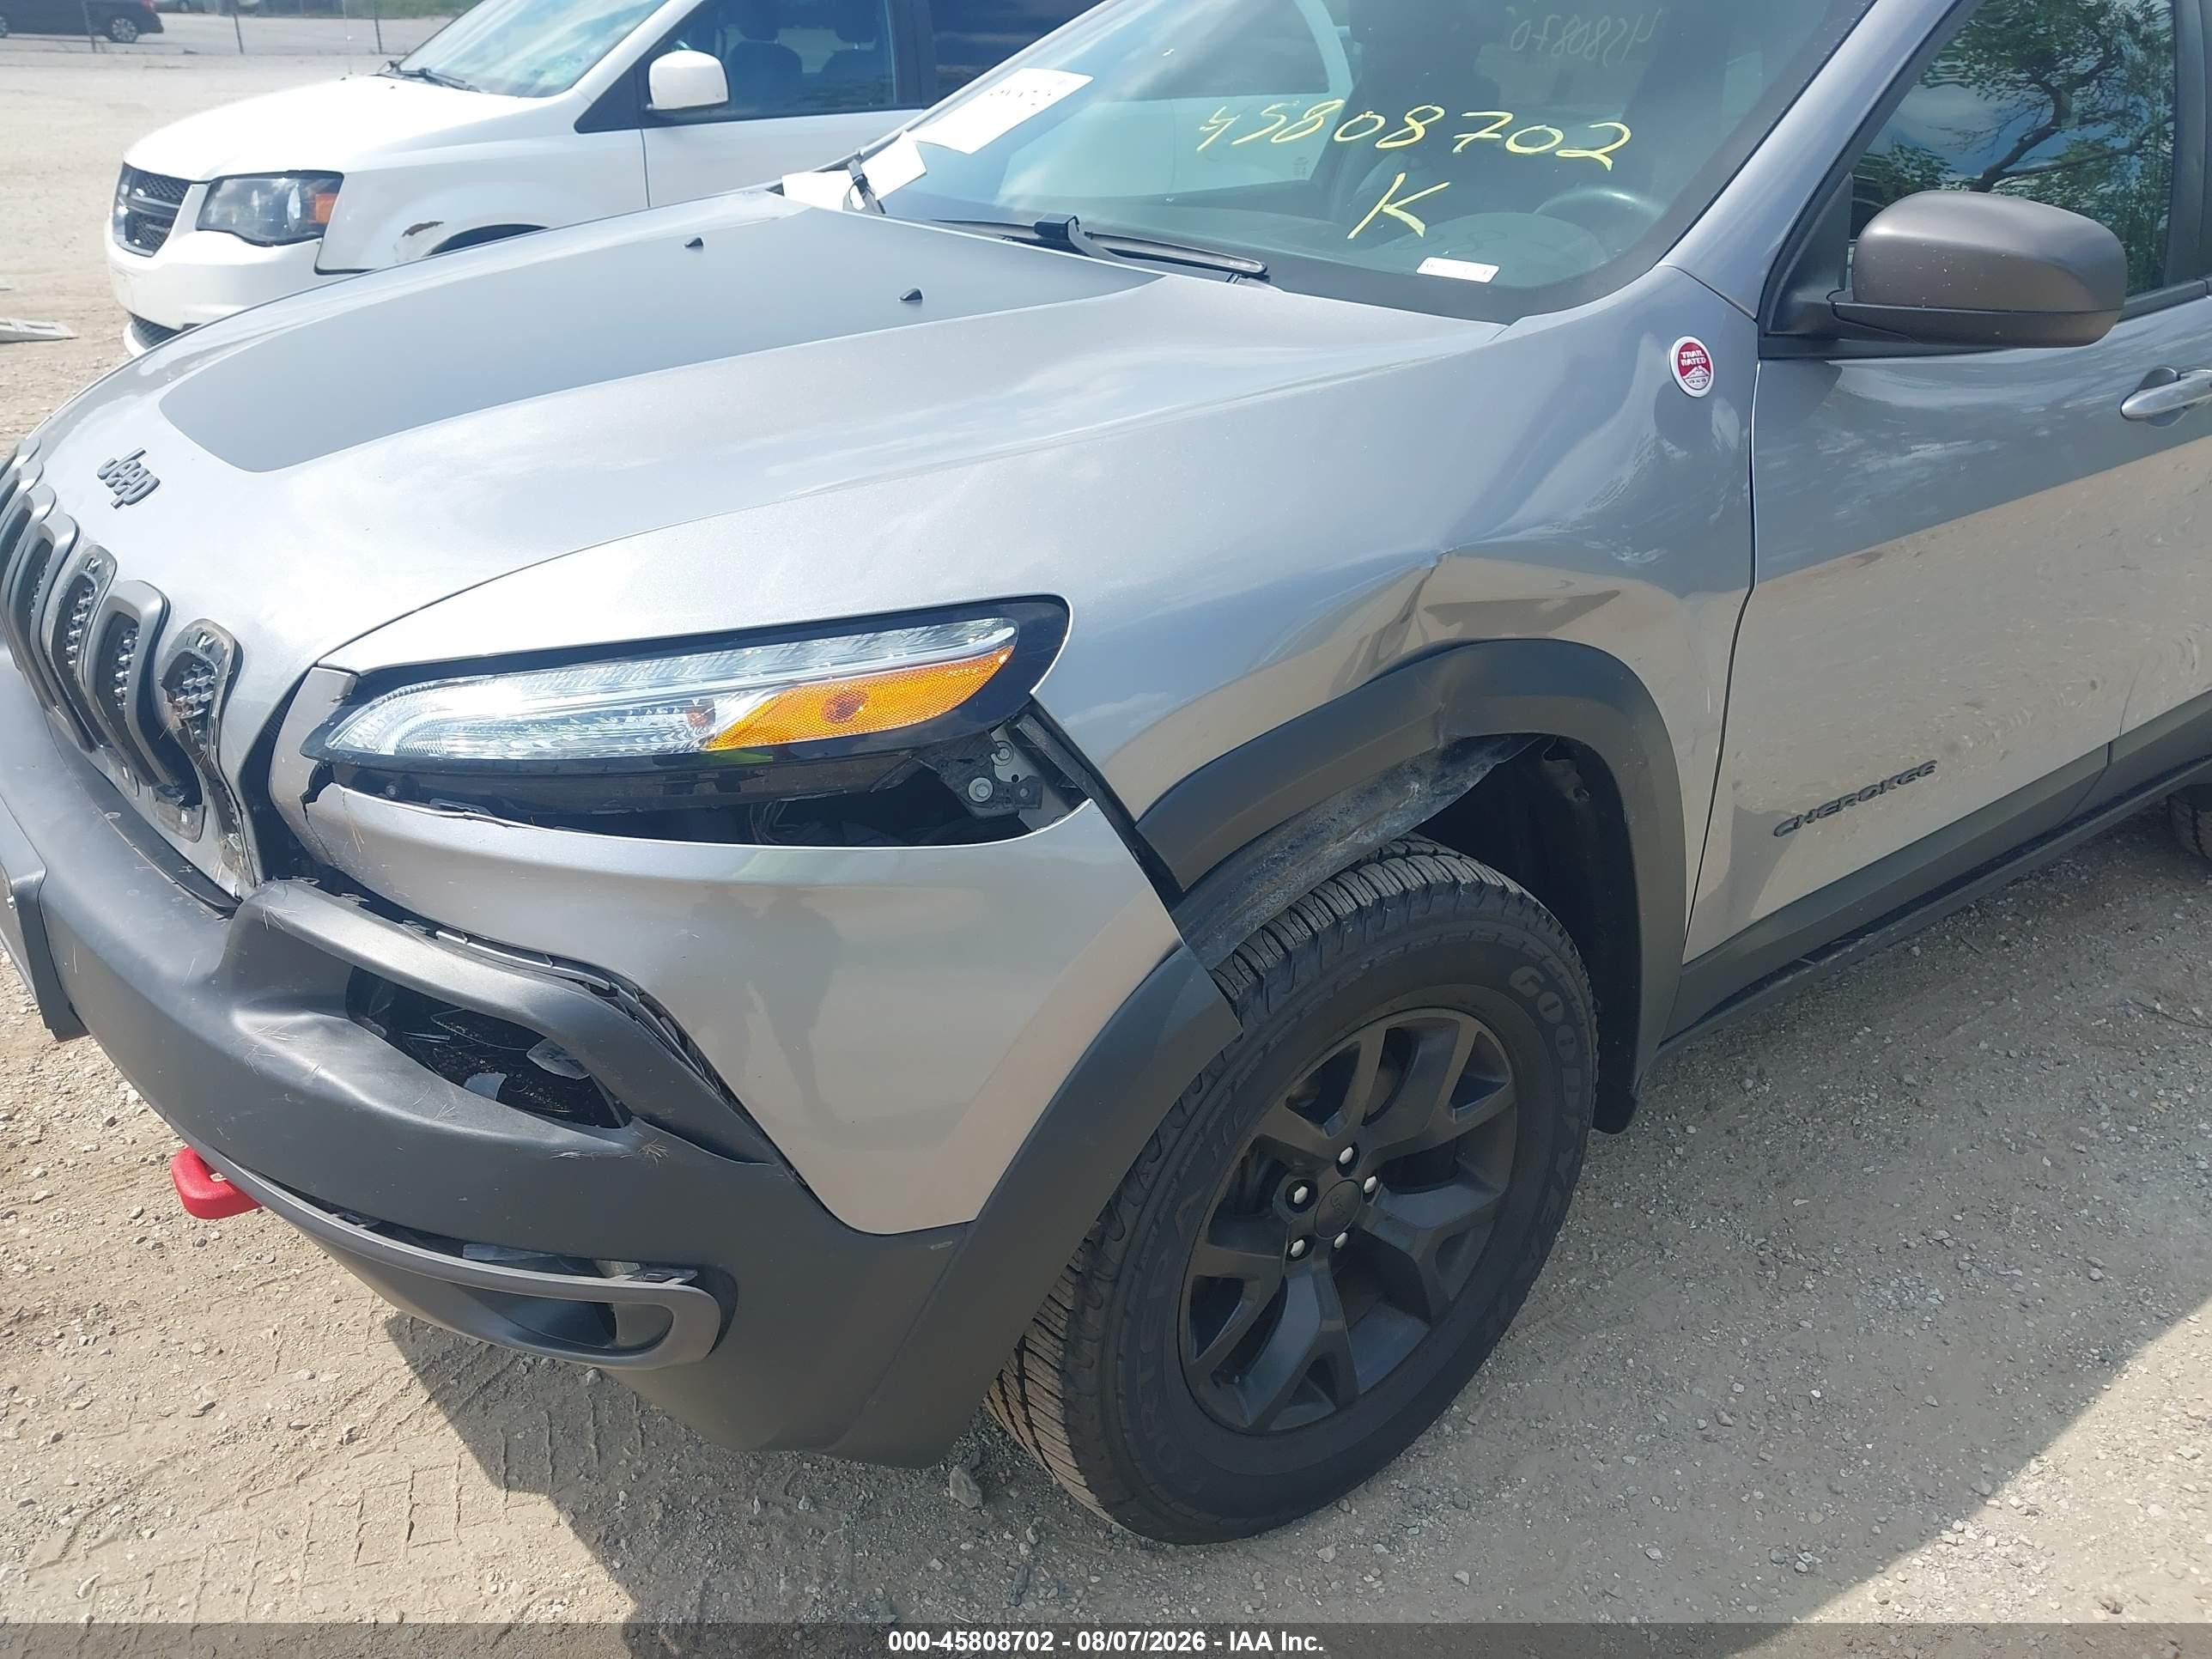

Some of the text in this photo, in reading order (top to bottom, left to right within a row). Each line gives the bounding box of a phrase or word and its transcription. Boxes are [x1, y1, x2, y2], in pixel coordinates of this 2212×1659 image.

[1197, 98, 1632, 172] 45808702
[1346, 172, 1451, 240] K
[1680, 349, 1705, 359] TRAIL
[1680, 357, 1707, 367] RATED
[97, 447, 161, 510] Jeep
[1773, 759, 1938, 837] CHEROKEE
